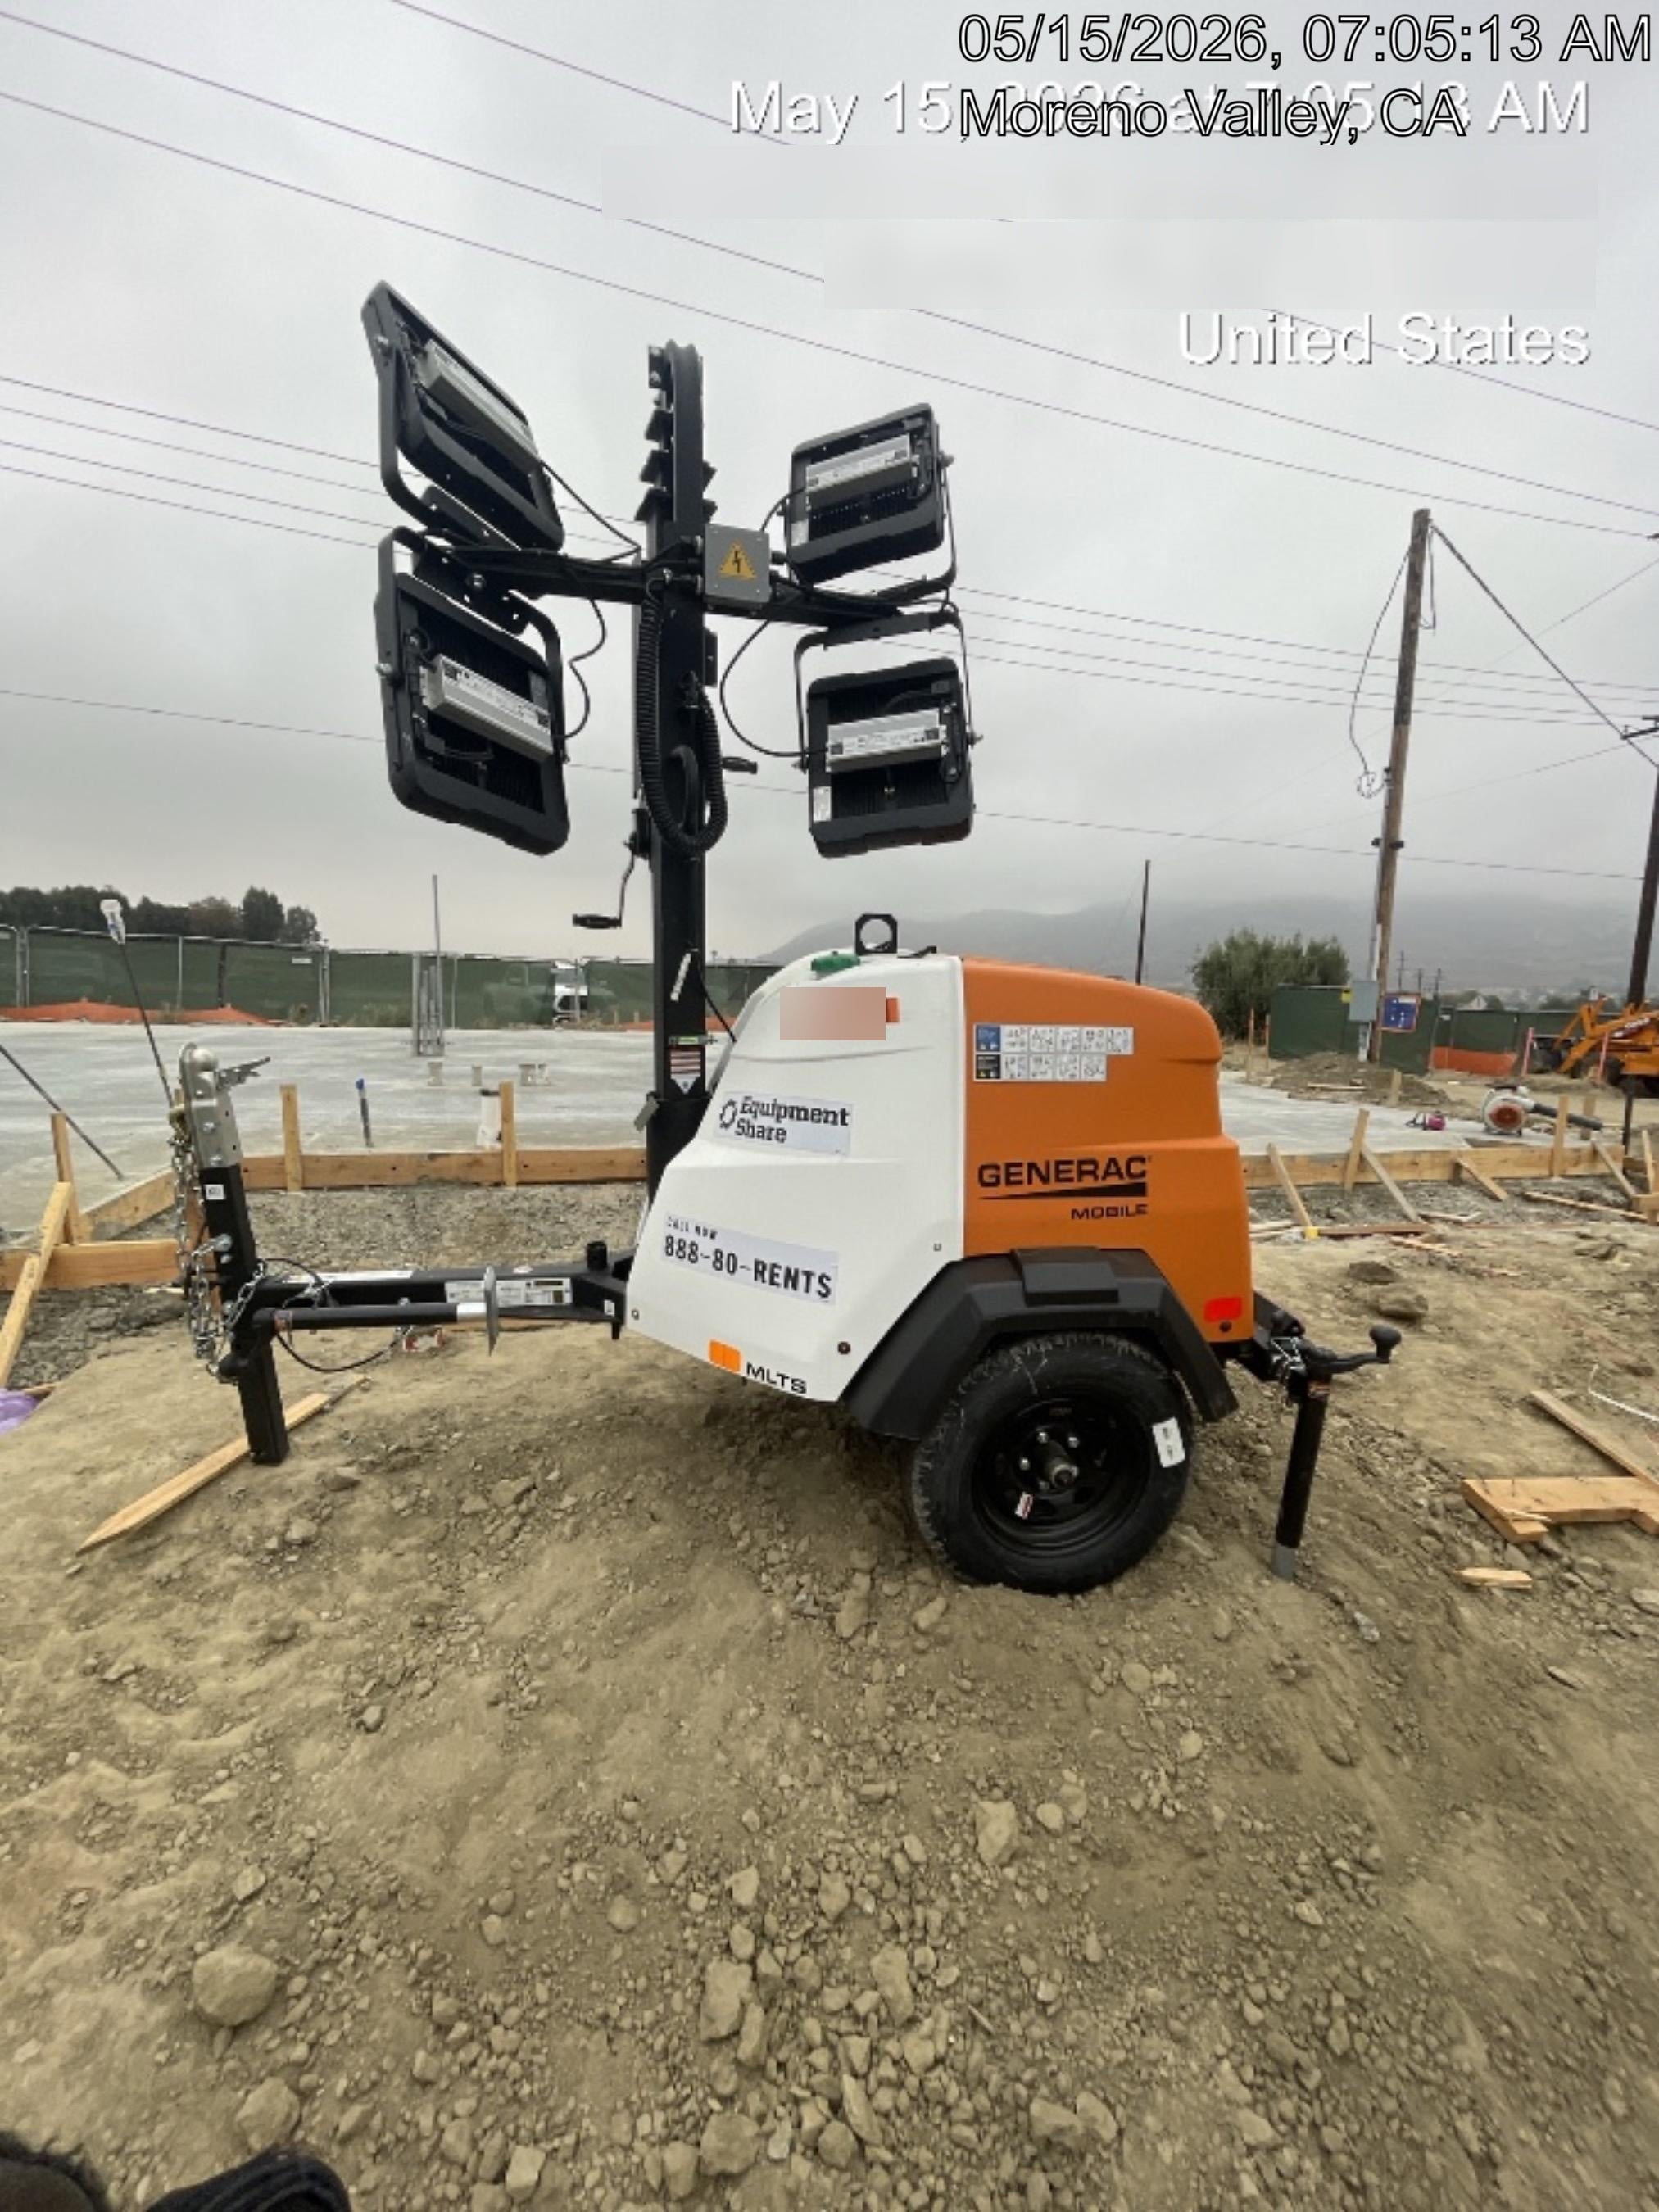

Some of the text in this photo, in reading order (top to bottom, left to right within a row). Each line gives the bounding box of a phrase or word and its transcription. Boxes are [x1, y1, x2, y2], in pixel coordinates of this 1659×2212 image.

[739, 1095, 851, 1127] Equipment
[735, 1117, 787, 1144] Share
[977, 1155, 1147, 1188] GENERAC
[1071, 1203, 1149, 1220] MOBILE
[664, 1234, 832, 1299] 888-80-RENTS
[746, 1362, 807, 1394] MLTS
